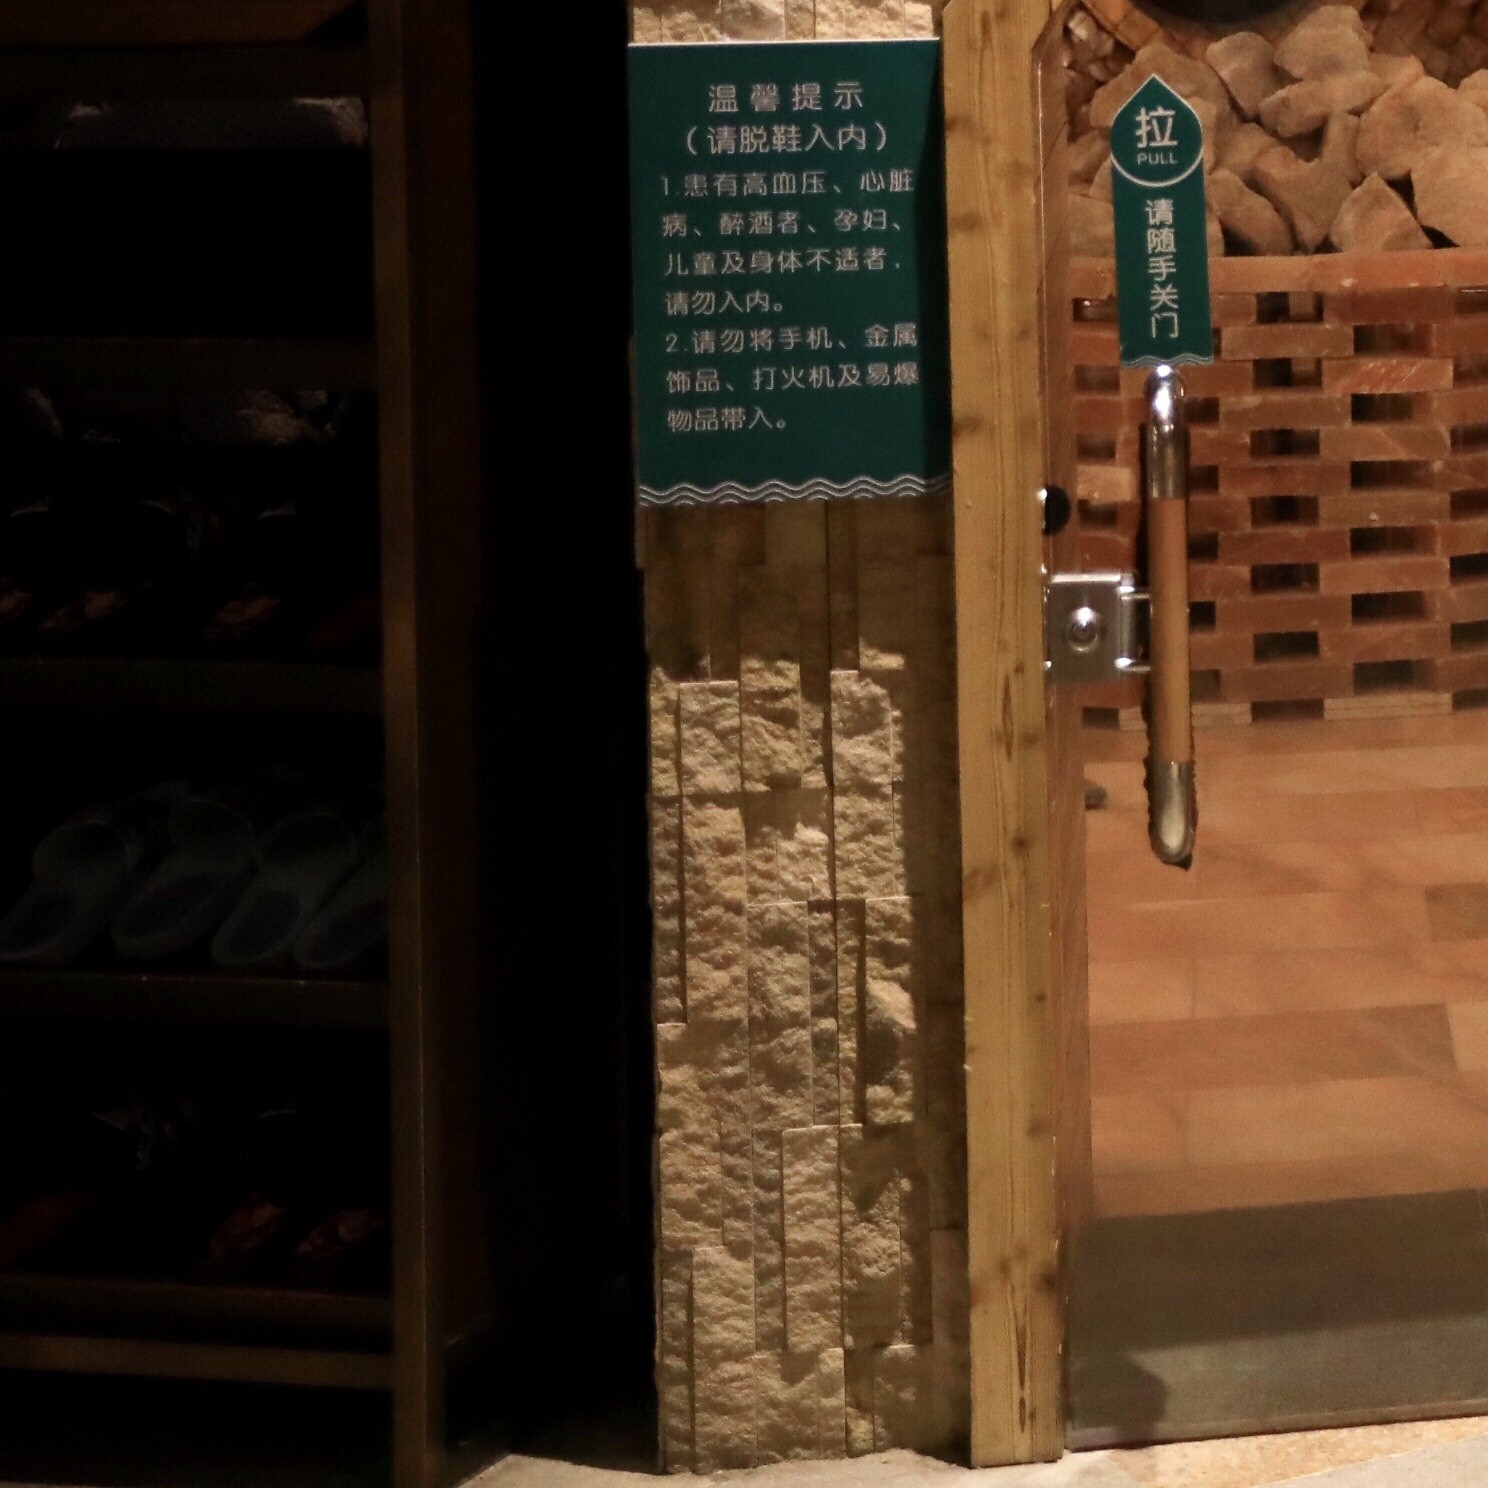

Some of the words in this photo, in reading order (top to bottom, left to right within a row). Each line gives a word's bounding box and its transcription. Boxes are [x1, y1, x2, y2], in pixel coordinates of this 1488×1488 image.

[708, 81, 864, 112] 温馨提示
[1134, 105, 1178, 149] 拉
[1136, 152, 1179, 166] PULL
[660, 168, 915, 197] 1.患有高血压、心脏
[1143, 198, 1180, 339] 请随手关门
[665, 290, 783, 316] 请勿入内。
[665, 322, 919, 355] 2.请勿将手机、金属
[666, 362, 920, 394] 饰品、打火机及易爆
[667, 406, 787, 432] 物品带入。
